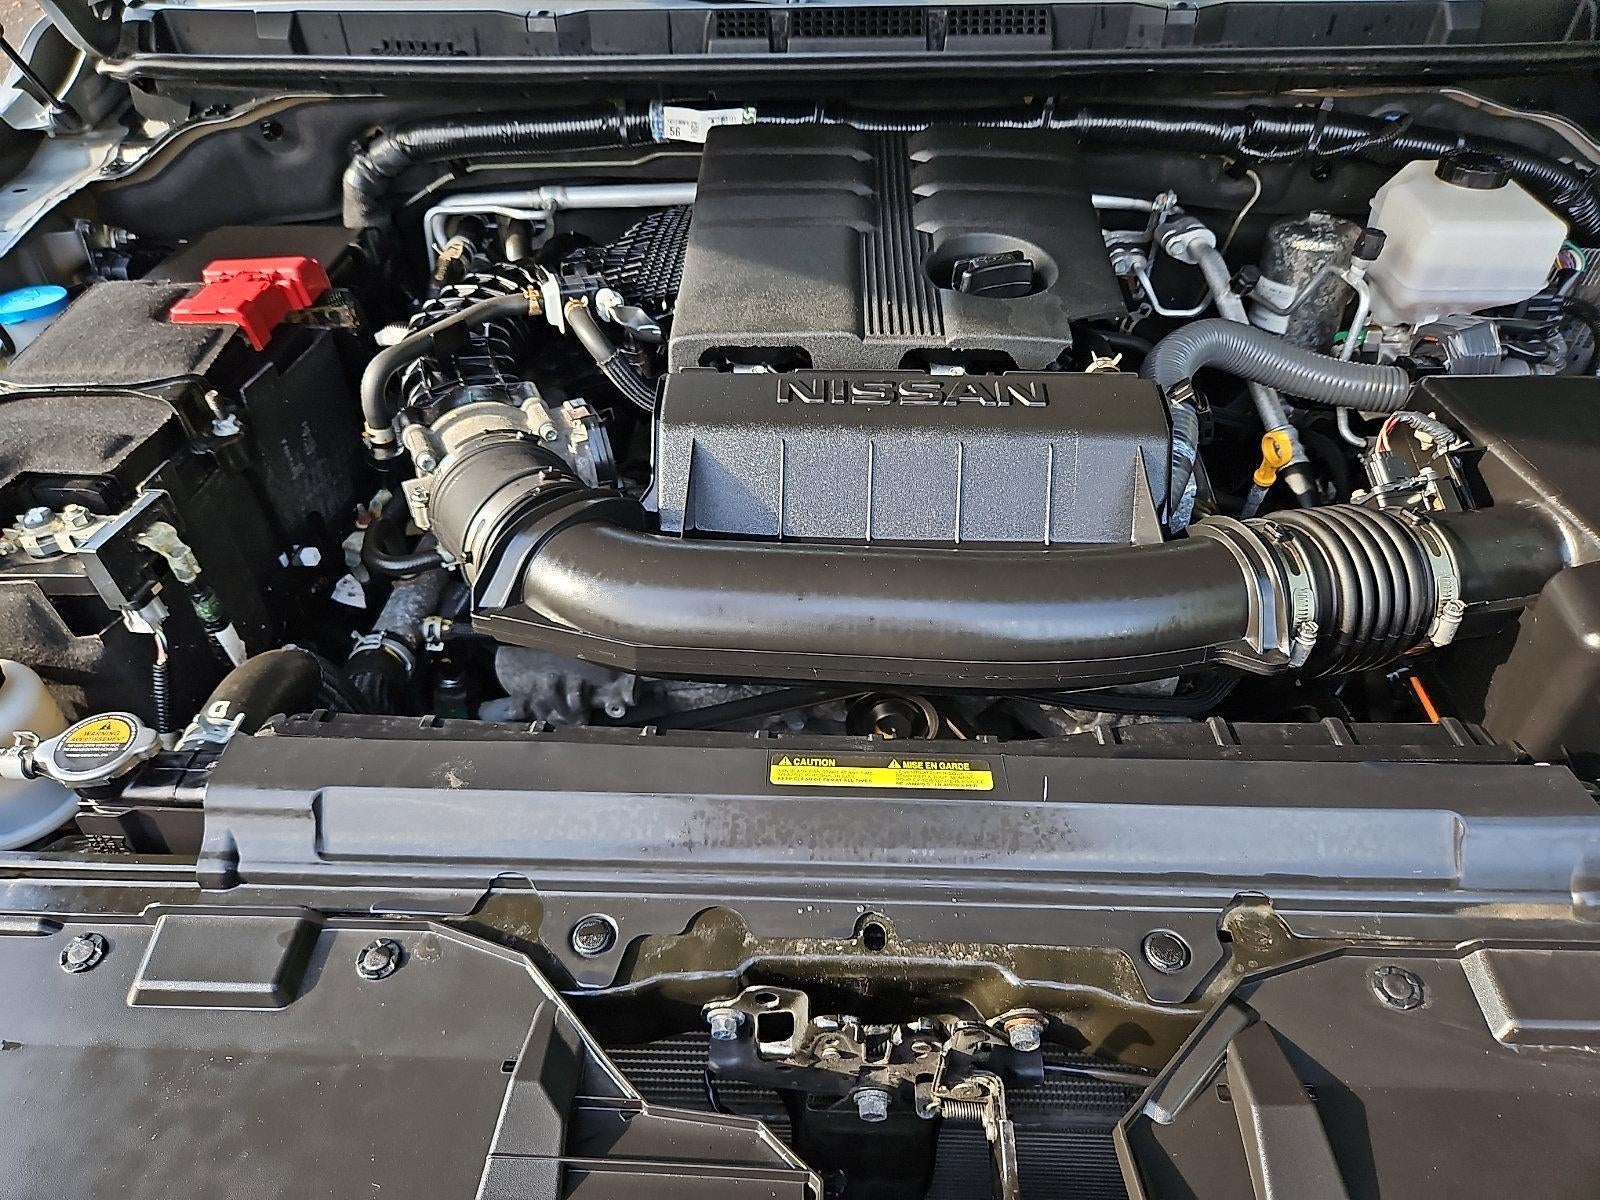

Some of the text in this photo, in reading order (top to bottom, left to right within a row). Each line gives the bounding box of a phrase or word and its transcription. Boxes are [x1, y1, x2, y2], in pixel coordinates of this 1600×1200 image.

[777, 378, 1048, 408] NISSAN
[793, 757, 836, 767] CAUTION
[902, 760, 971, 771] MISE EN GARDE
